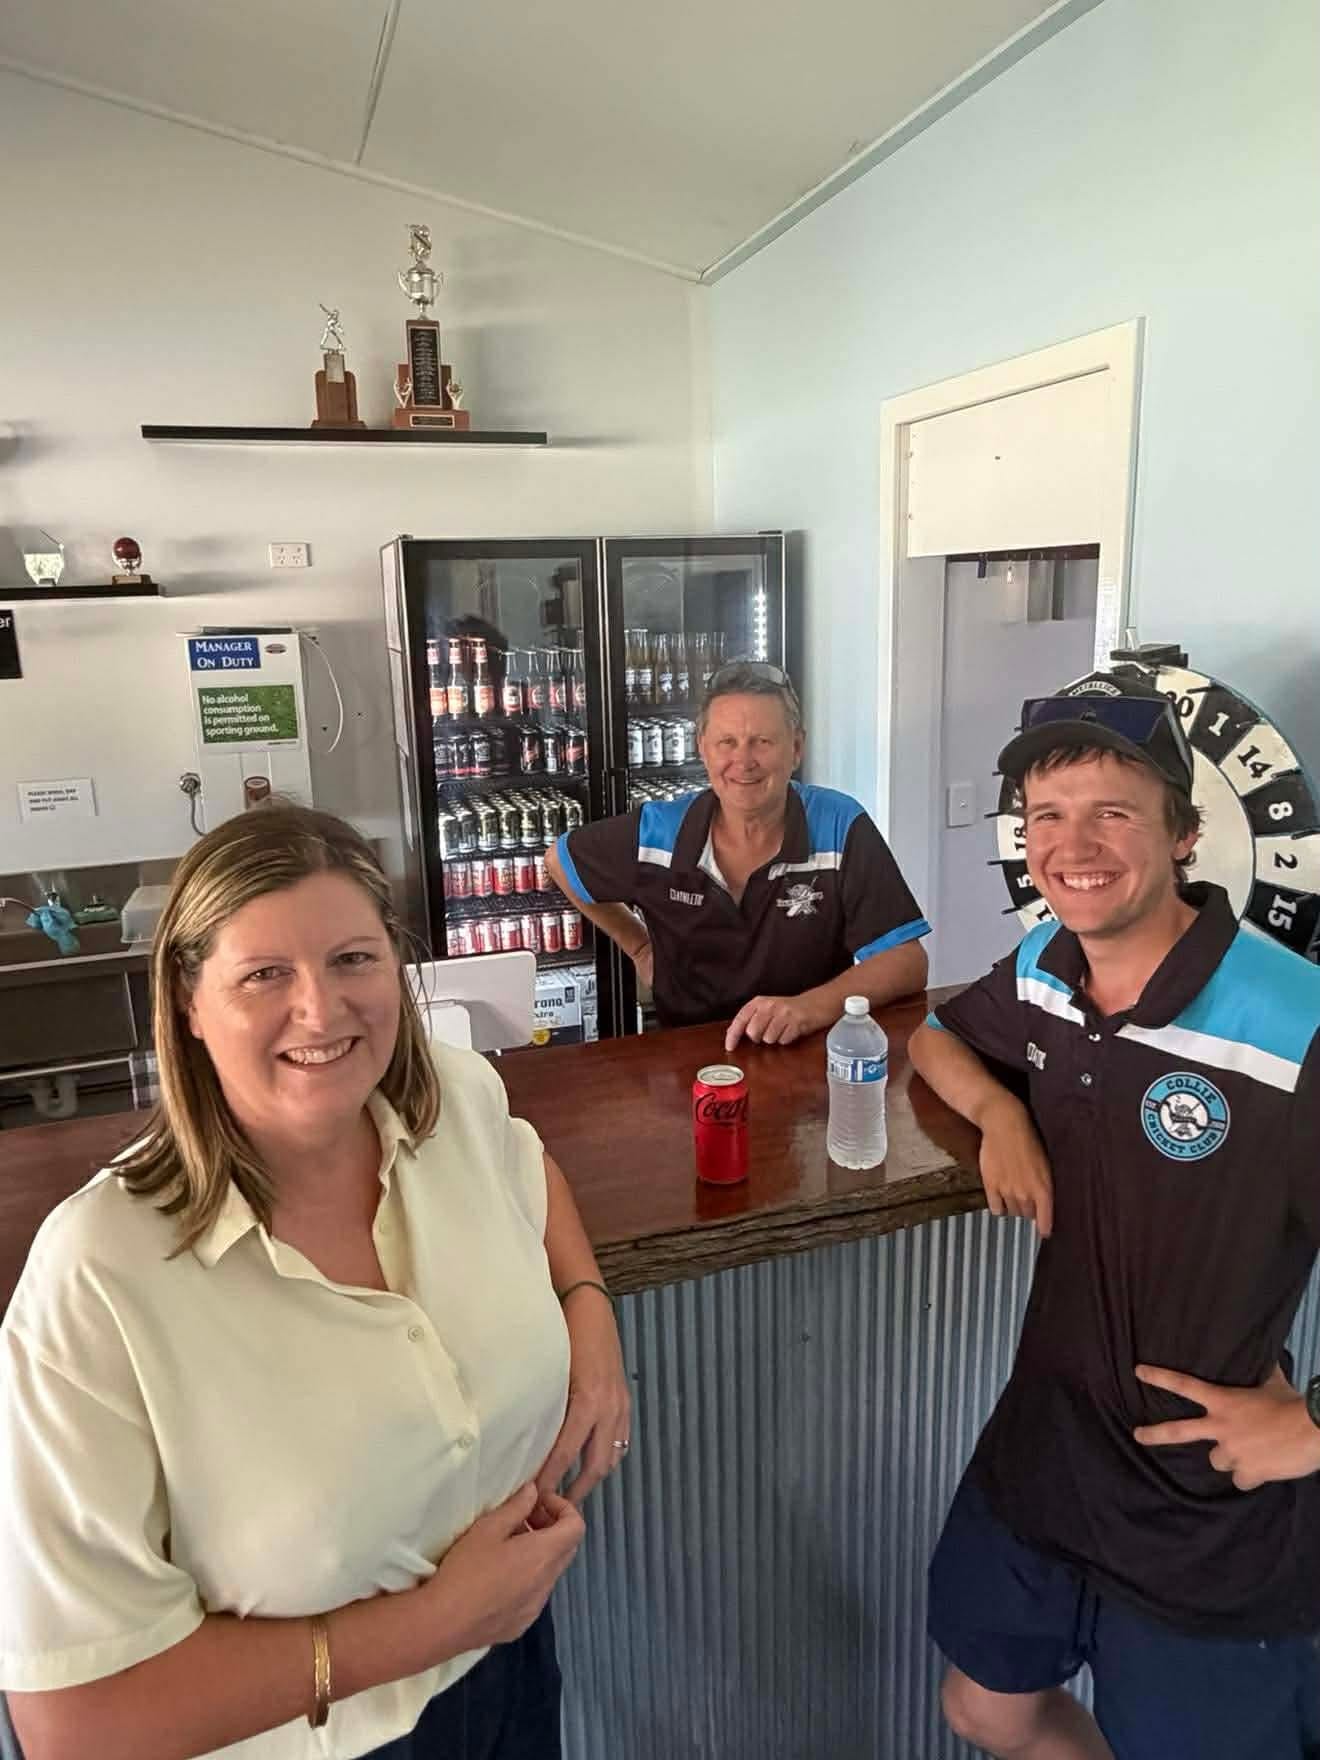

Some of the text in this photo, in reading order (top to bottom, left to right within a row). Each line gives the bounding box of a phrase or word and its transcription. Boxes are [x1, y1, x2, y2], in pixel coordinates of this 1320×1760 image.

[0, 616, 11, 628] er
[195, 641, 252, 653] MANAGER
[222, 656, 254, 667] DUTY
[202, 693, 249, 704] No alcohol
[203, 704, 262, 715] consumption
[213, 714, 257, 726] permitted
[259, 714, 270, 722] on
[1208, 711, 1229, 736] 1
[206, 725, 242, 737] sporting
[1237, 744, 1272, 780] 14
[1268, 801, 1293, 821] 8
[1273, 852, 1298, 870] 2
[1267, 894, 1297, 931] 15
[534, 998, 564, 1009] rona
[535, 1010, 555, 1018] tra
[1166, 1078, 1217, 1104] COLLIE
[695, 1092, 748, 1126] Coca
[1147, 1113, 1218, 1154] CRICKET CLUB
